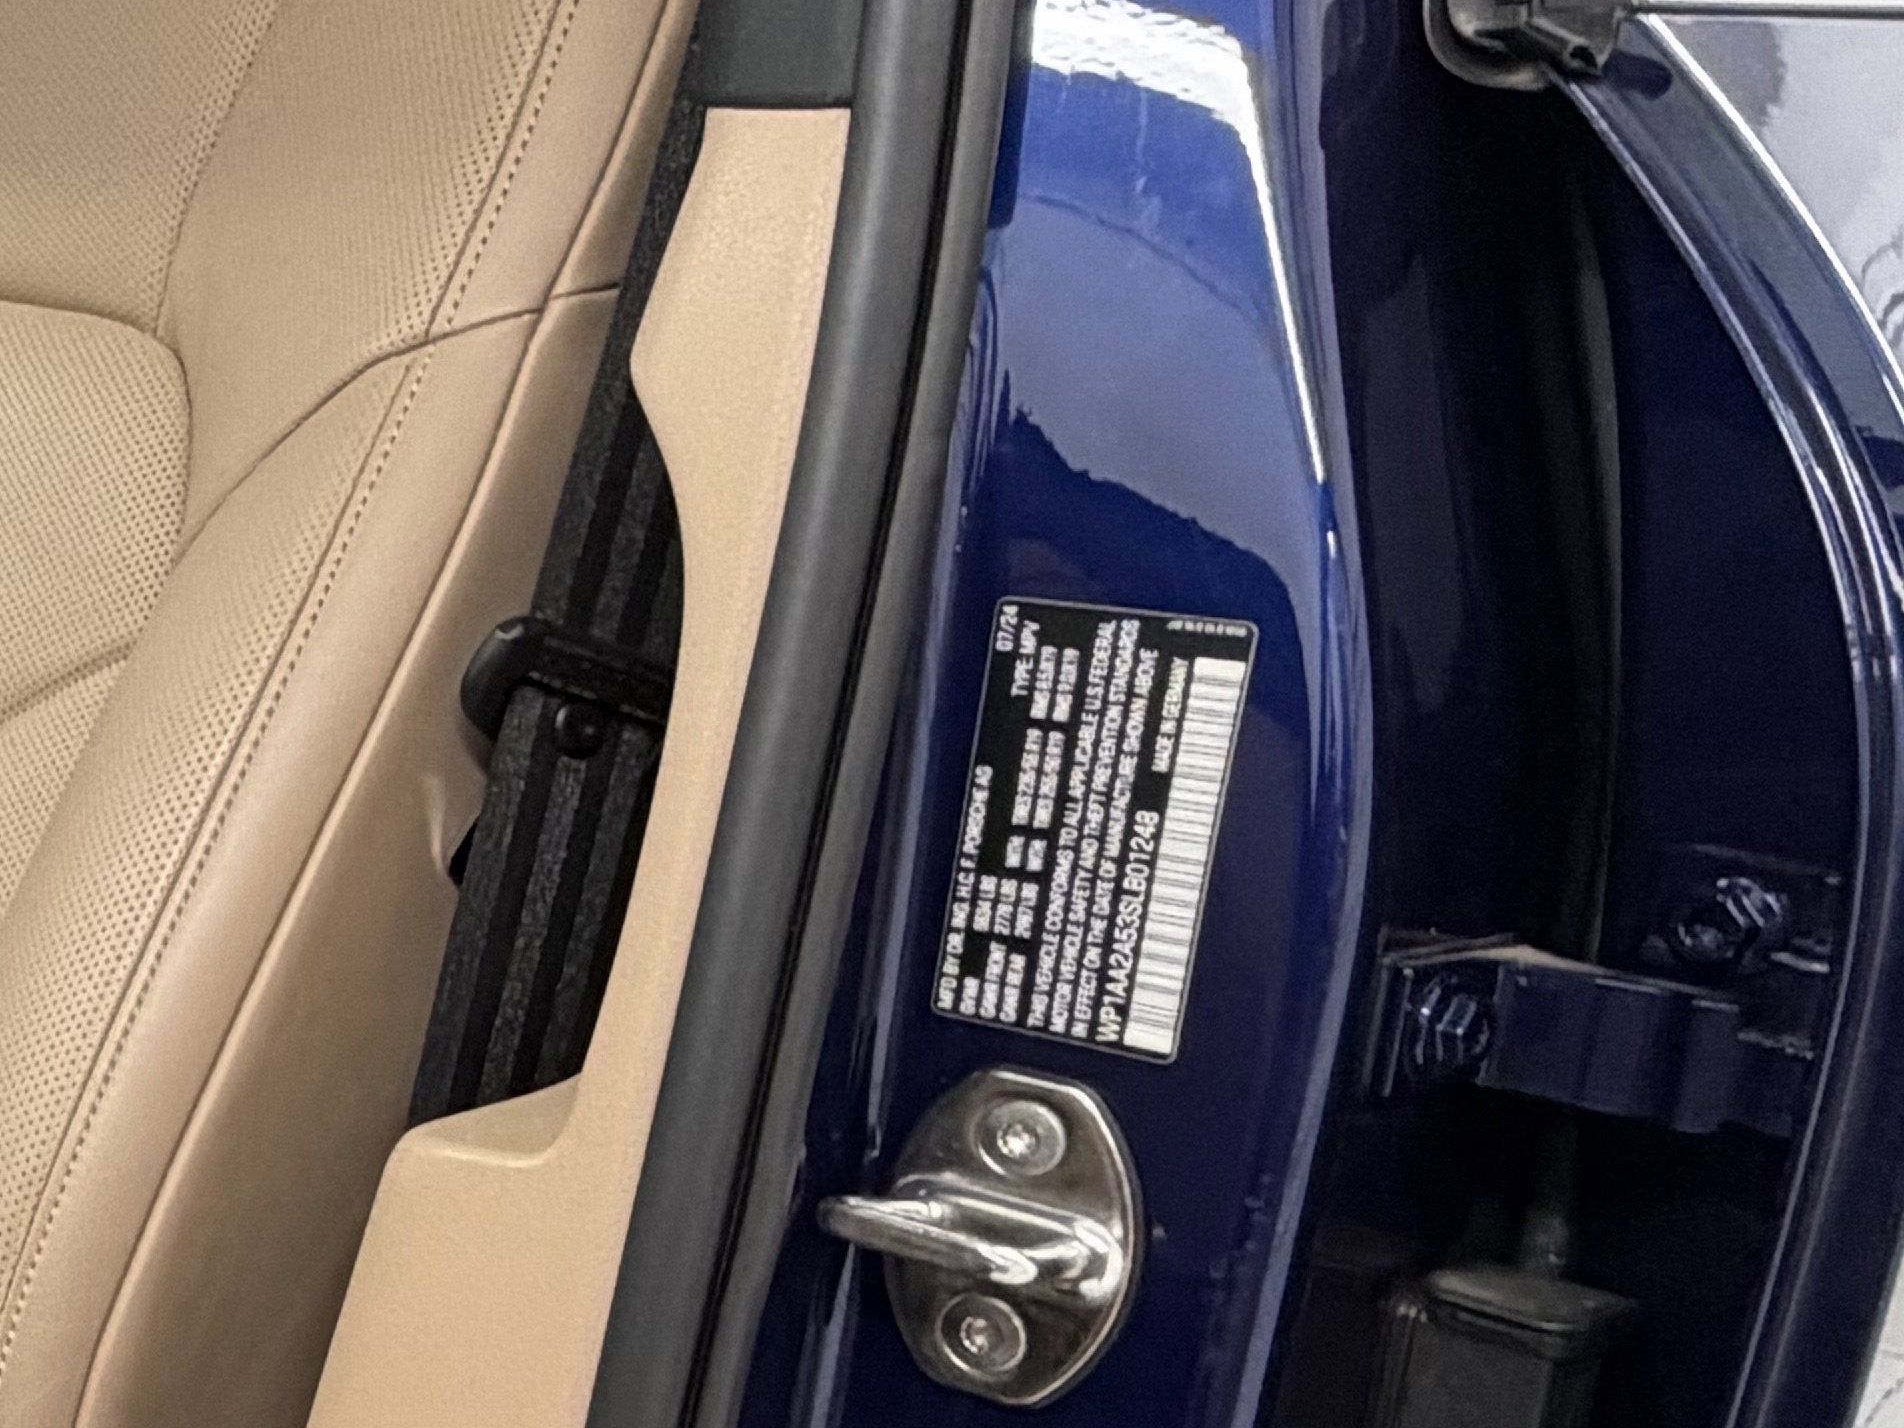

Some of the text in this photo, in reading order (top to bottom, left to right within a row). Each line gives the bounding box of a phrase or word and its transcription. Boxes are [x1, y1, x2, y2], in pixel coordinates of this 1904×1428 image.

[997, 604, 1018, 651] 07/24
[1133, 648, 1158, 695] ABOVE
[1123, 697, 1148, 752] SHOWN
[1068, 712, 1099, 799] APPLICABLE
[962, 785, 989, 854] PORSCHE
[1049, 618, 1140, 1032] MOTOR VEHICLE SAFETY AND THEFT PREVENTION STANDARDS
[1063, 800, 1083, 826] ALL
[1104, 754, 1137, 857] MANUFACTURE
[1059, 827, 1078, 847] TO
[1045, 849, 1074, 931] CONFORMS
[1100, 859, 1118, 877] OF
[1093, 880, 1114, 914] DATE
[1088, 917, 1107, 944] THE
[1034, 932, 1059, 992] VEHICLE
[1084, 945, 1102, 968] ON
[1028, 993, 1048, 1029] THIS
[1075, 969, 1098, 1020] EFFECT
